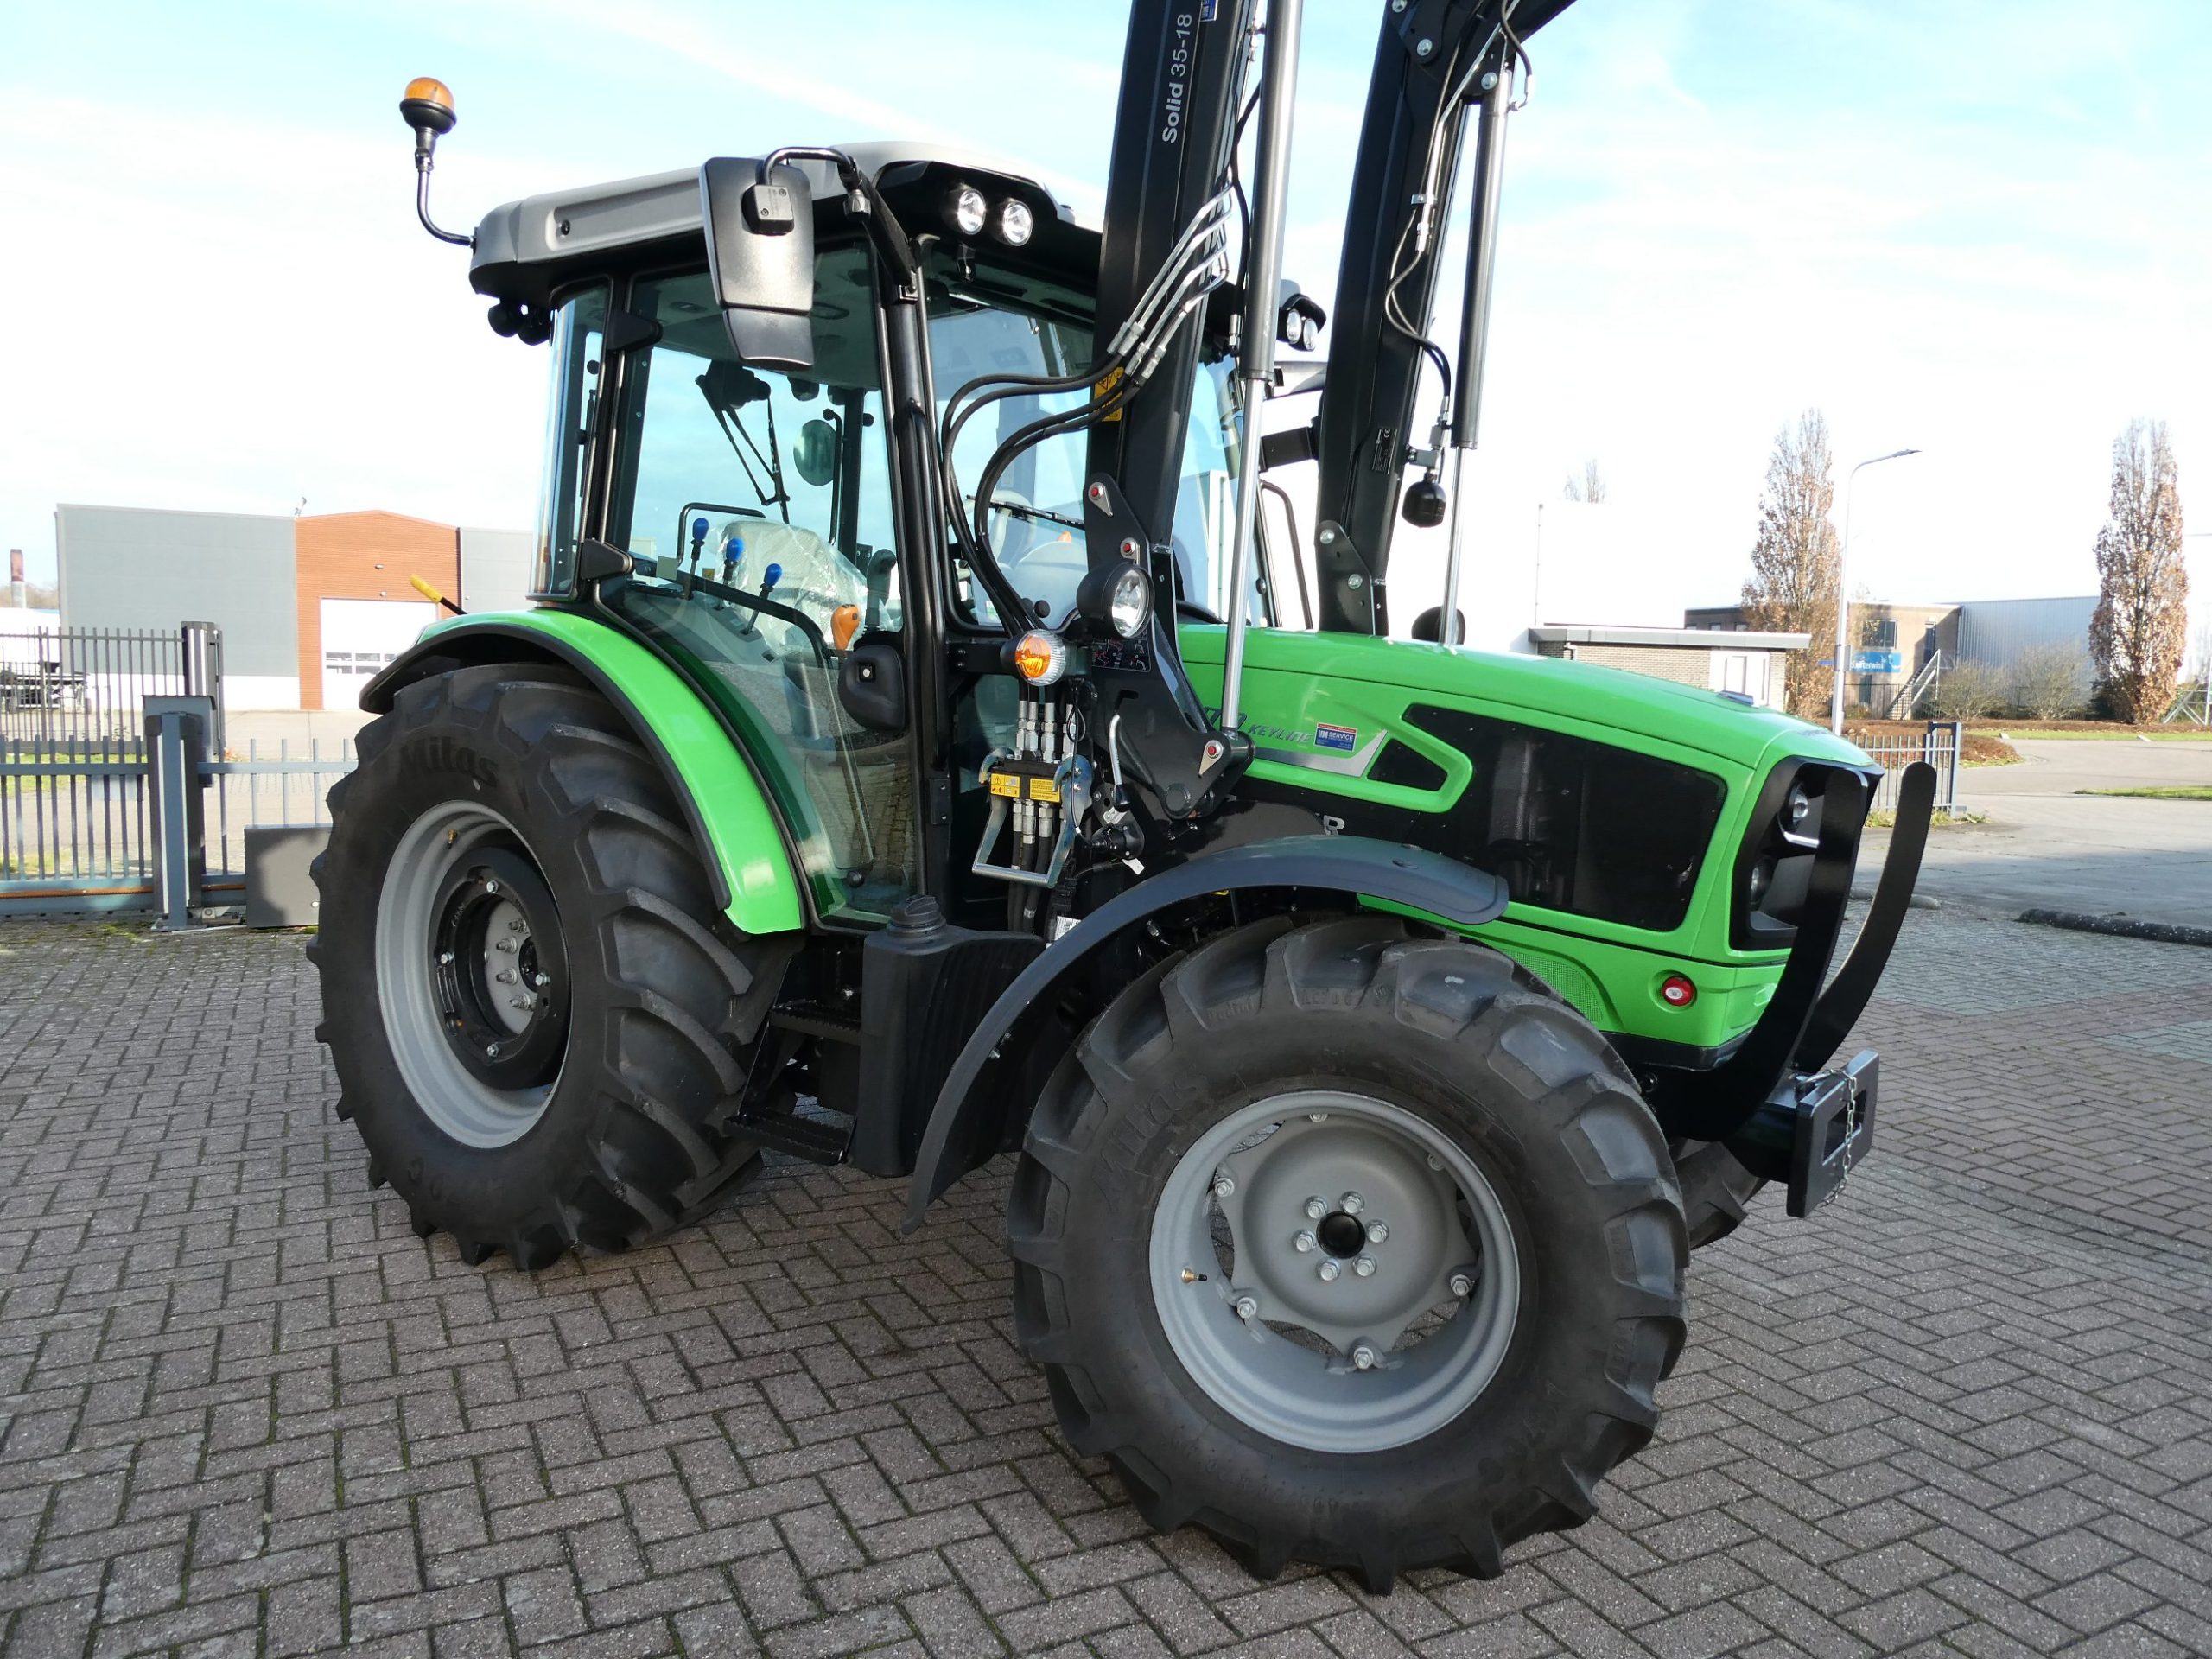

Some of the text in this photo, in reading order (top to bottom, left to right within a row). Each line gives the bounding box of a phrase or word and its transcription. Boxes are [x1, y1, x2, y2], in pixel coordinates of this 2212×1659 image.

[1161, 14, 1193, 144] Solid 35-18
[1247, 723, 1313, 744] KEYLINE
[1328, 732, 1354, 741] SERVICE
[400, 735, 499, 788] Mitas
